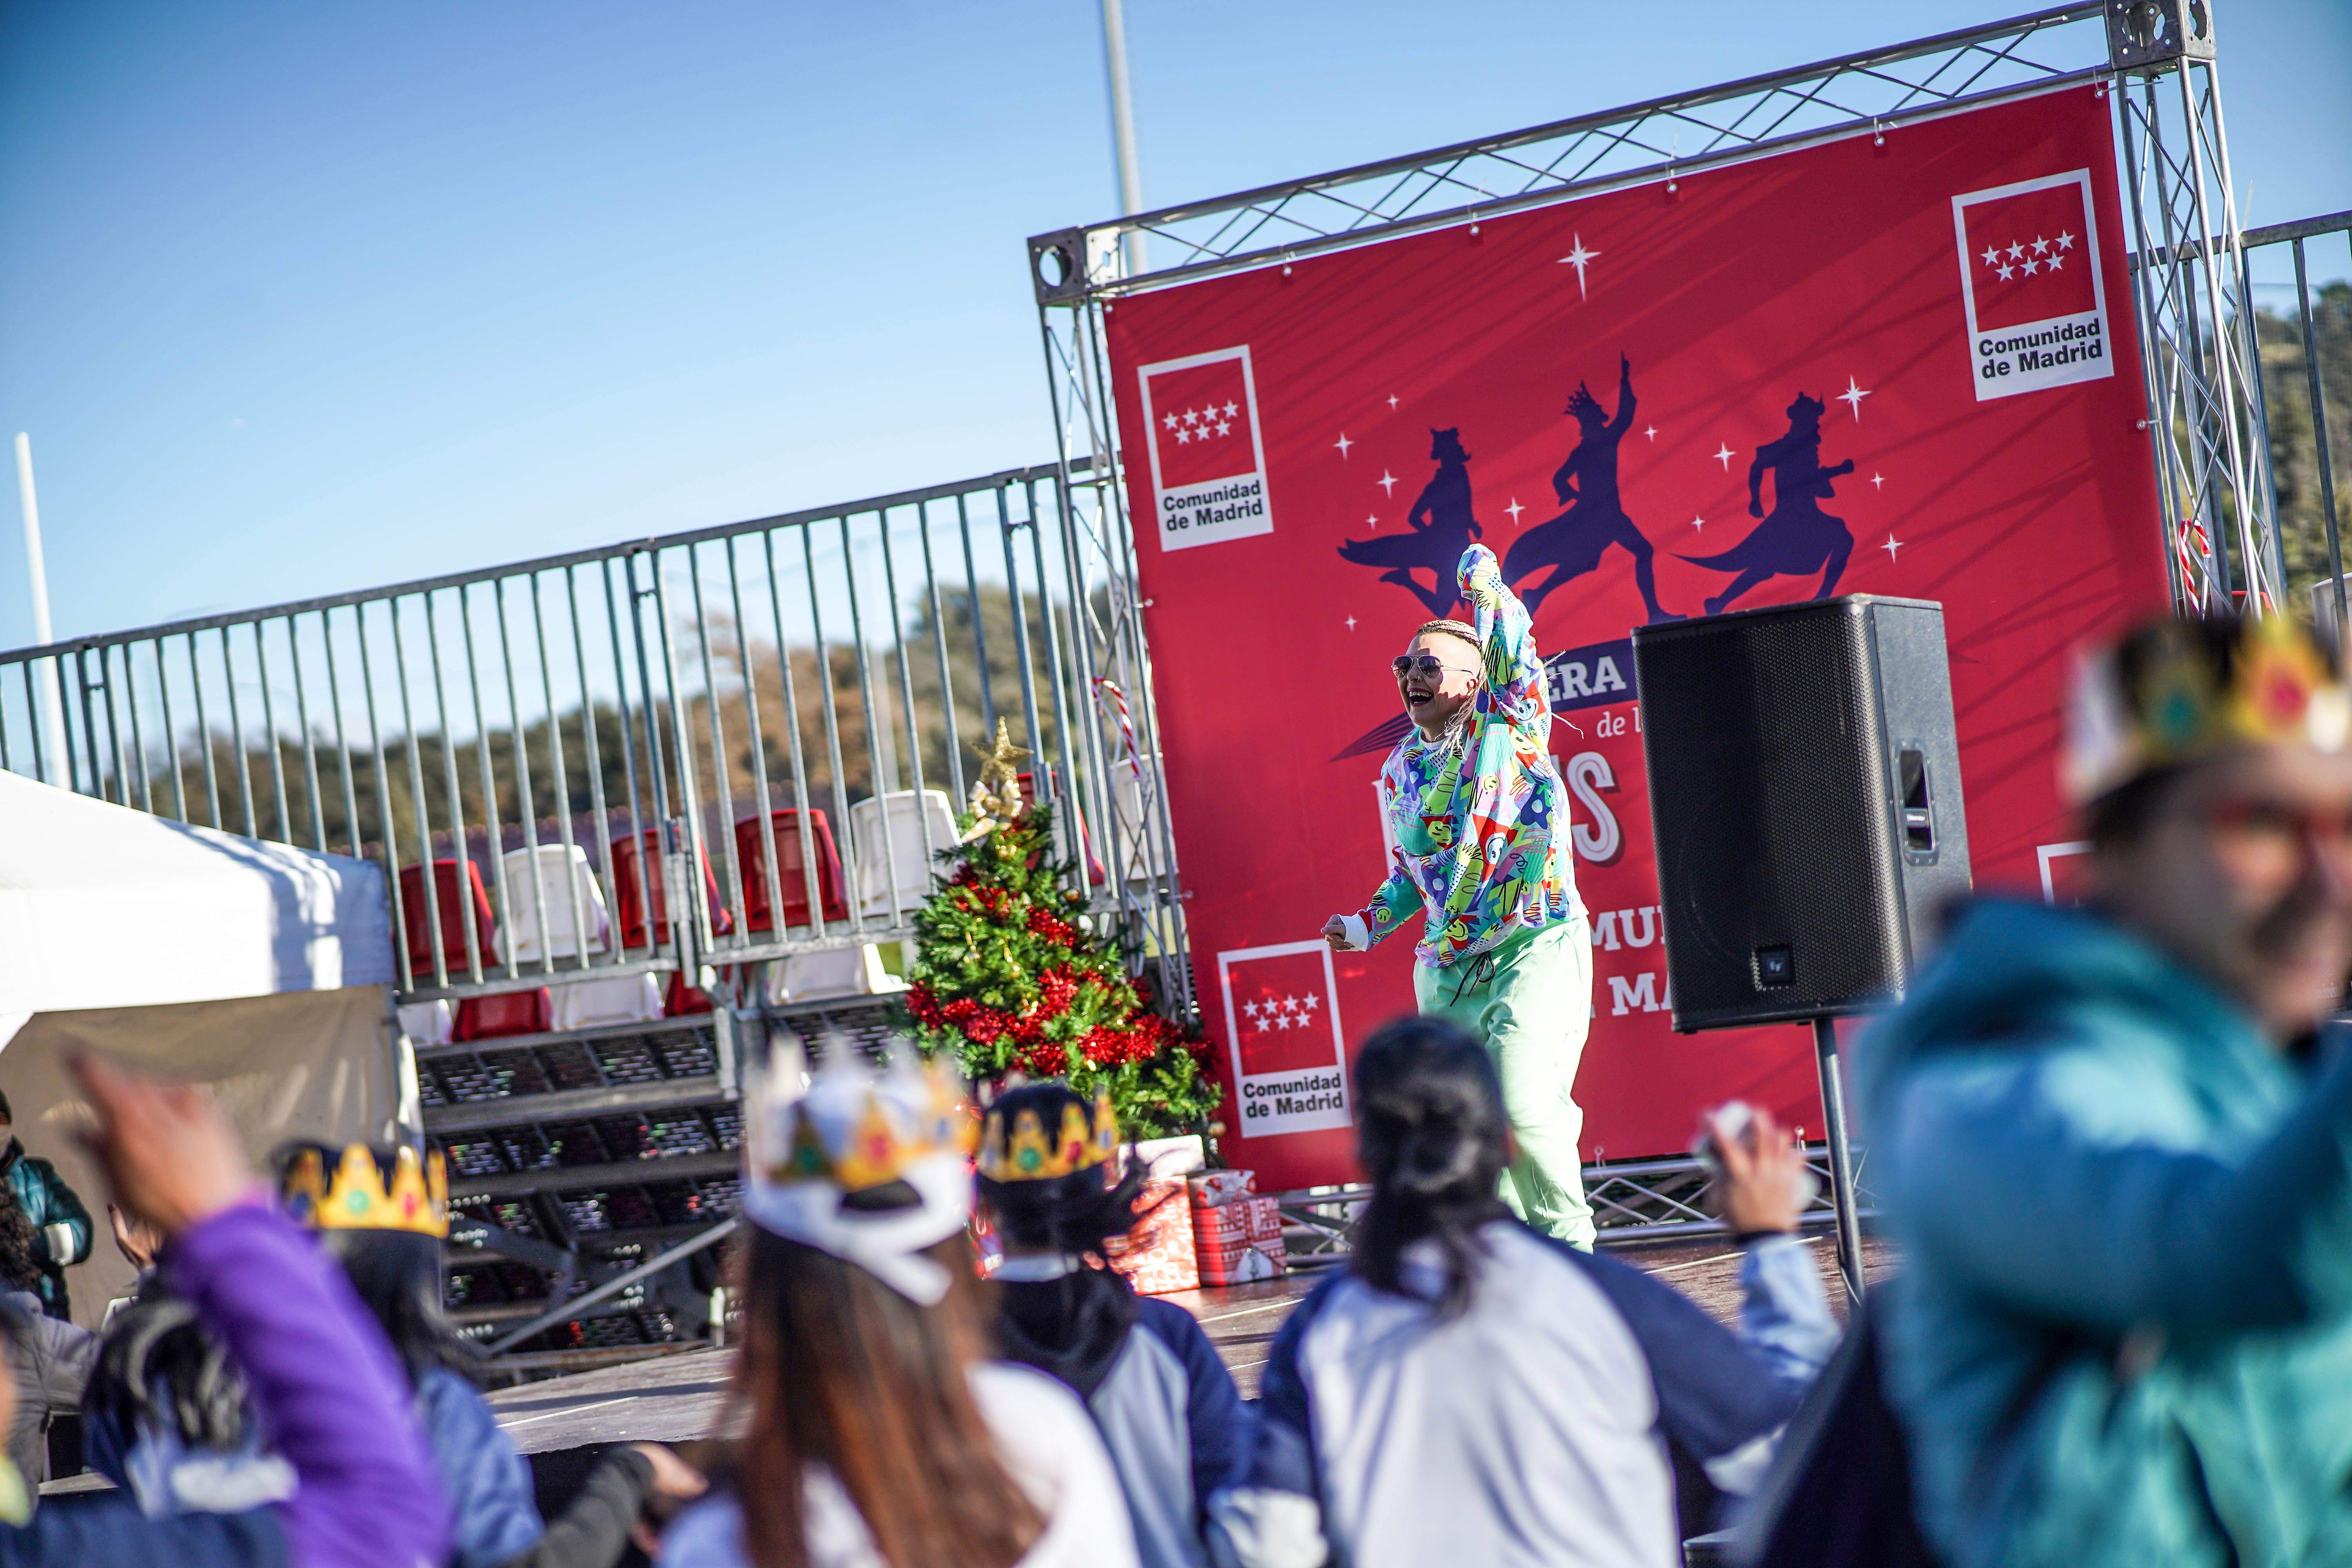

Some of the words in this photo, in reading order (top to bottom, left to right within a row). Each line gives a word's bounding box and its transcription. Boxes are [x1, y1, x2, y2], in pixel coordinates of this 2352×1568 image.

[1978, 318, 2100, 356] Comunidad
[1981, 359, 2010, 379] de
[2018, 338, 2102, 372] Madrid
[1163, 479, 1261, 511] Comunidad
[1166, 514, 1189, 531] de
[1195, 498, 1263, 526] Madrid
[1597, 711, 1626, 738] de
[1243, 1073, 1341, 1098] Comunidad
[1245, 1100, 1269, 1118] de
[1276, 1091, 1343, 1115] Madrid
